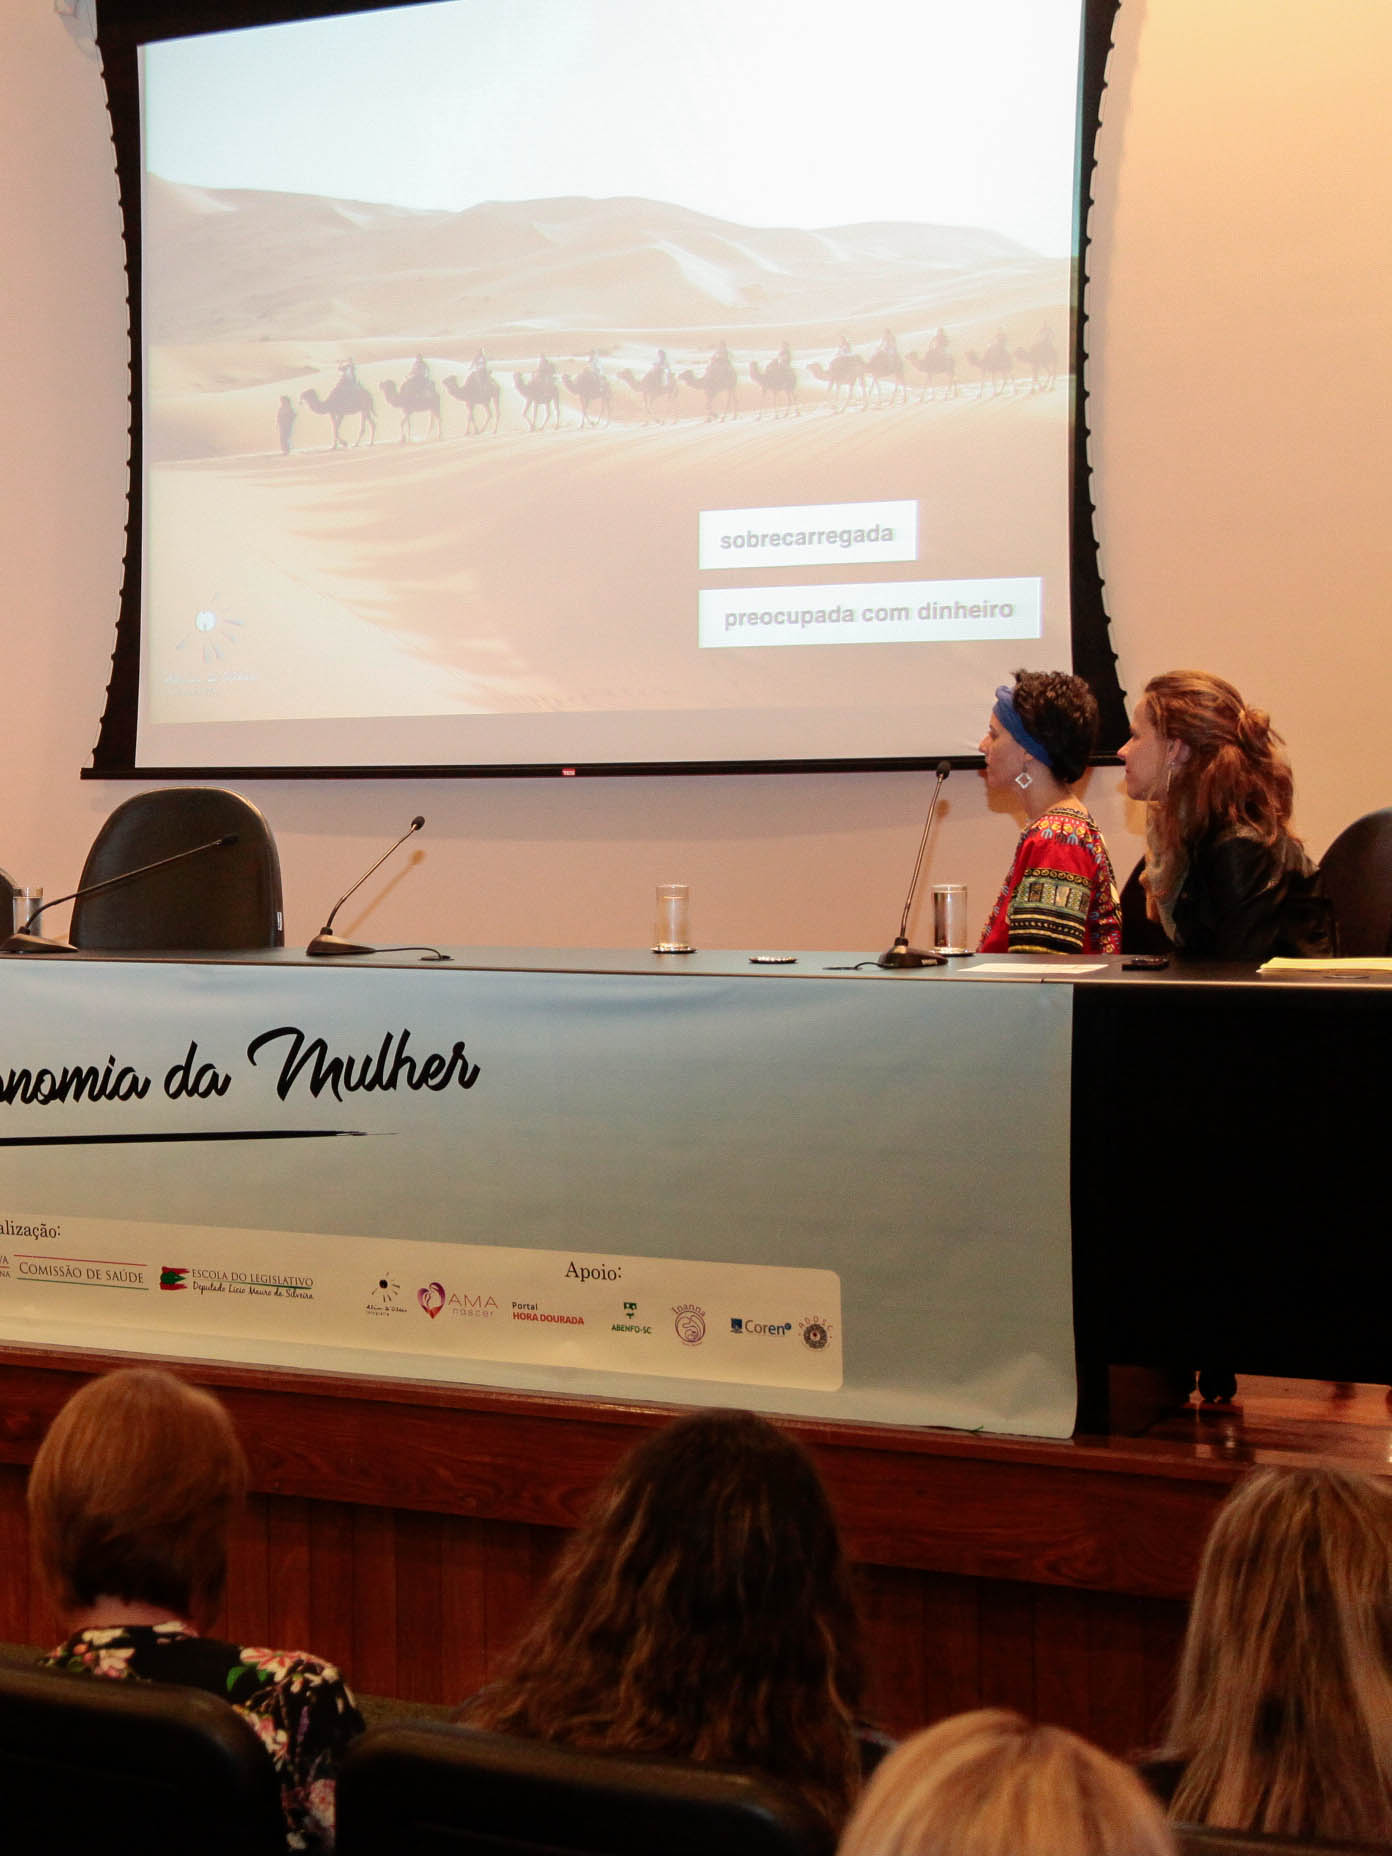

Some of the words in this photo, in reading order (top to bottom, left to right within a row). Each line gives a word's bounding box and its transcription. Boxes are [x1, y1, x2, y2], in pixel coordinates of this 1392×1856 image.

[720, 523, 894, 549] sobrecarregada
[725, 606, 855, 631] preocupada
[861, 608, 910, 623] com
[917, 600, 1014, 621] dinheiro
[164, 1041, 231, 1100] da
[248, 1026, 481, 1102] Mulher
[19, 1261, 82, 1279] COMISSÃO
[86, 1268, 102, 1280] DE
[106, 1269, 144, 1284] SAÚDE
[192, 1269, 228, 1281] ESCOLA
[231, 1272, 247, 1281] DO
[251, 1273, 314, 1287] LEGISLATIVO
[565, 1261, 622, 1282] Apoio:
[448, 1293, 498, 1309] AMA
[512, 1302, 538, 1311] Portal
[513, 1312, 539, 1322] HORA
[540, 1314, 585, 1326] DOURADA
